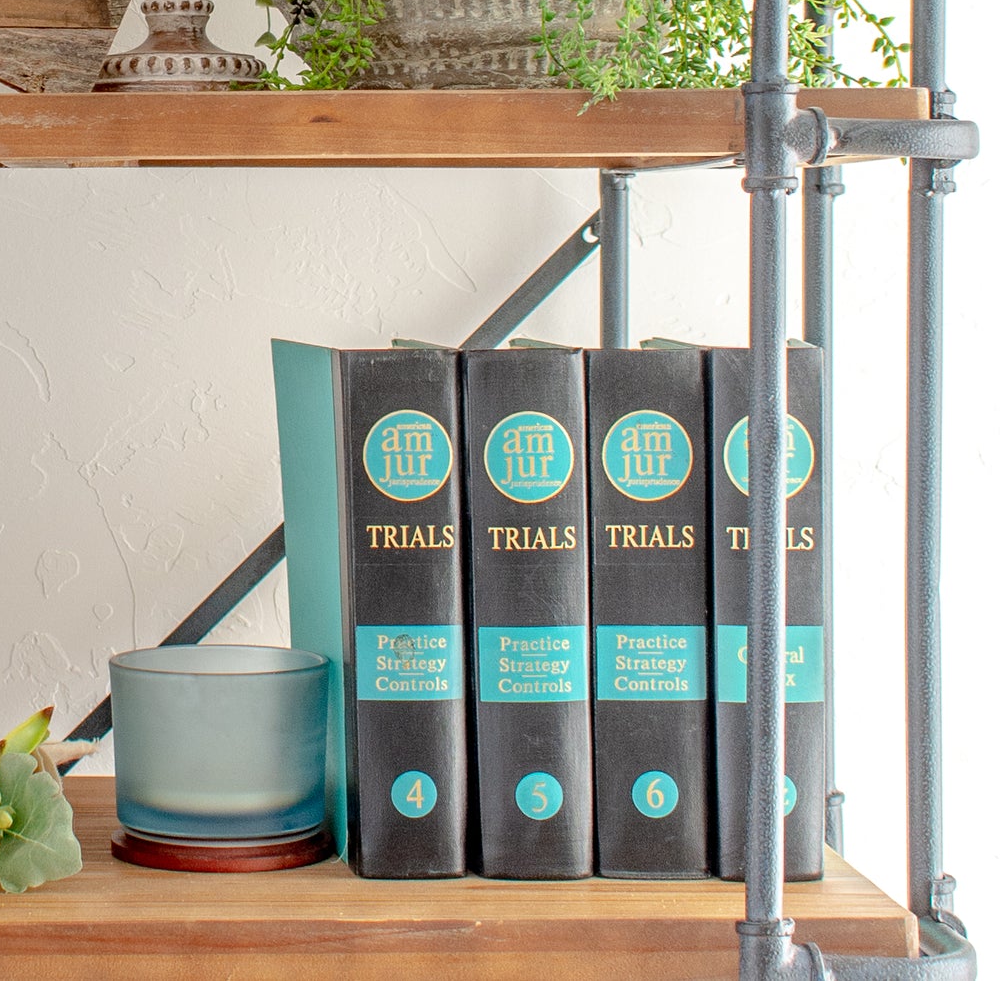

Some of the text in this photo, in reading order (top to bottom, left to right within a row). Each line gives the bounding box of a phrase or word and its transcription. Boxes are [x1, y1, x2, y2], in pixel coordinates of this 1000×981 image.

[381, 427, 434, 452] am
[503, 428, 555, 454] am
[621, 427, 673, 452] am
[379, 453, 433, 483] jur
[501, 455, 554, 485] jur
[618, 453, 672, 483] jur
[366, 524, 455, 549] TRIALS
[488, 526, 577, 551] TRIALS
[605, 524, 695, 549] TRIALS
[725, 526, 815, 551] TLS
[499, 635, 571, 652] Practice
[616, 634, 688, 650] Practice
[376, 655, 447, 673] Strategy
[499, 657, 571, 675] Strategy
[615, 655, 688, 673] Strategy
[375, 676, 449, 692] Controls
[498, 678, 573, 694] Controls
[614, 676, 690, 692] Controls
[406, 778, 425, 809] 4
[531, 781, 549, 813] 5
[646, 777, 665, 809] 6
